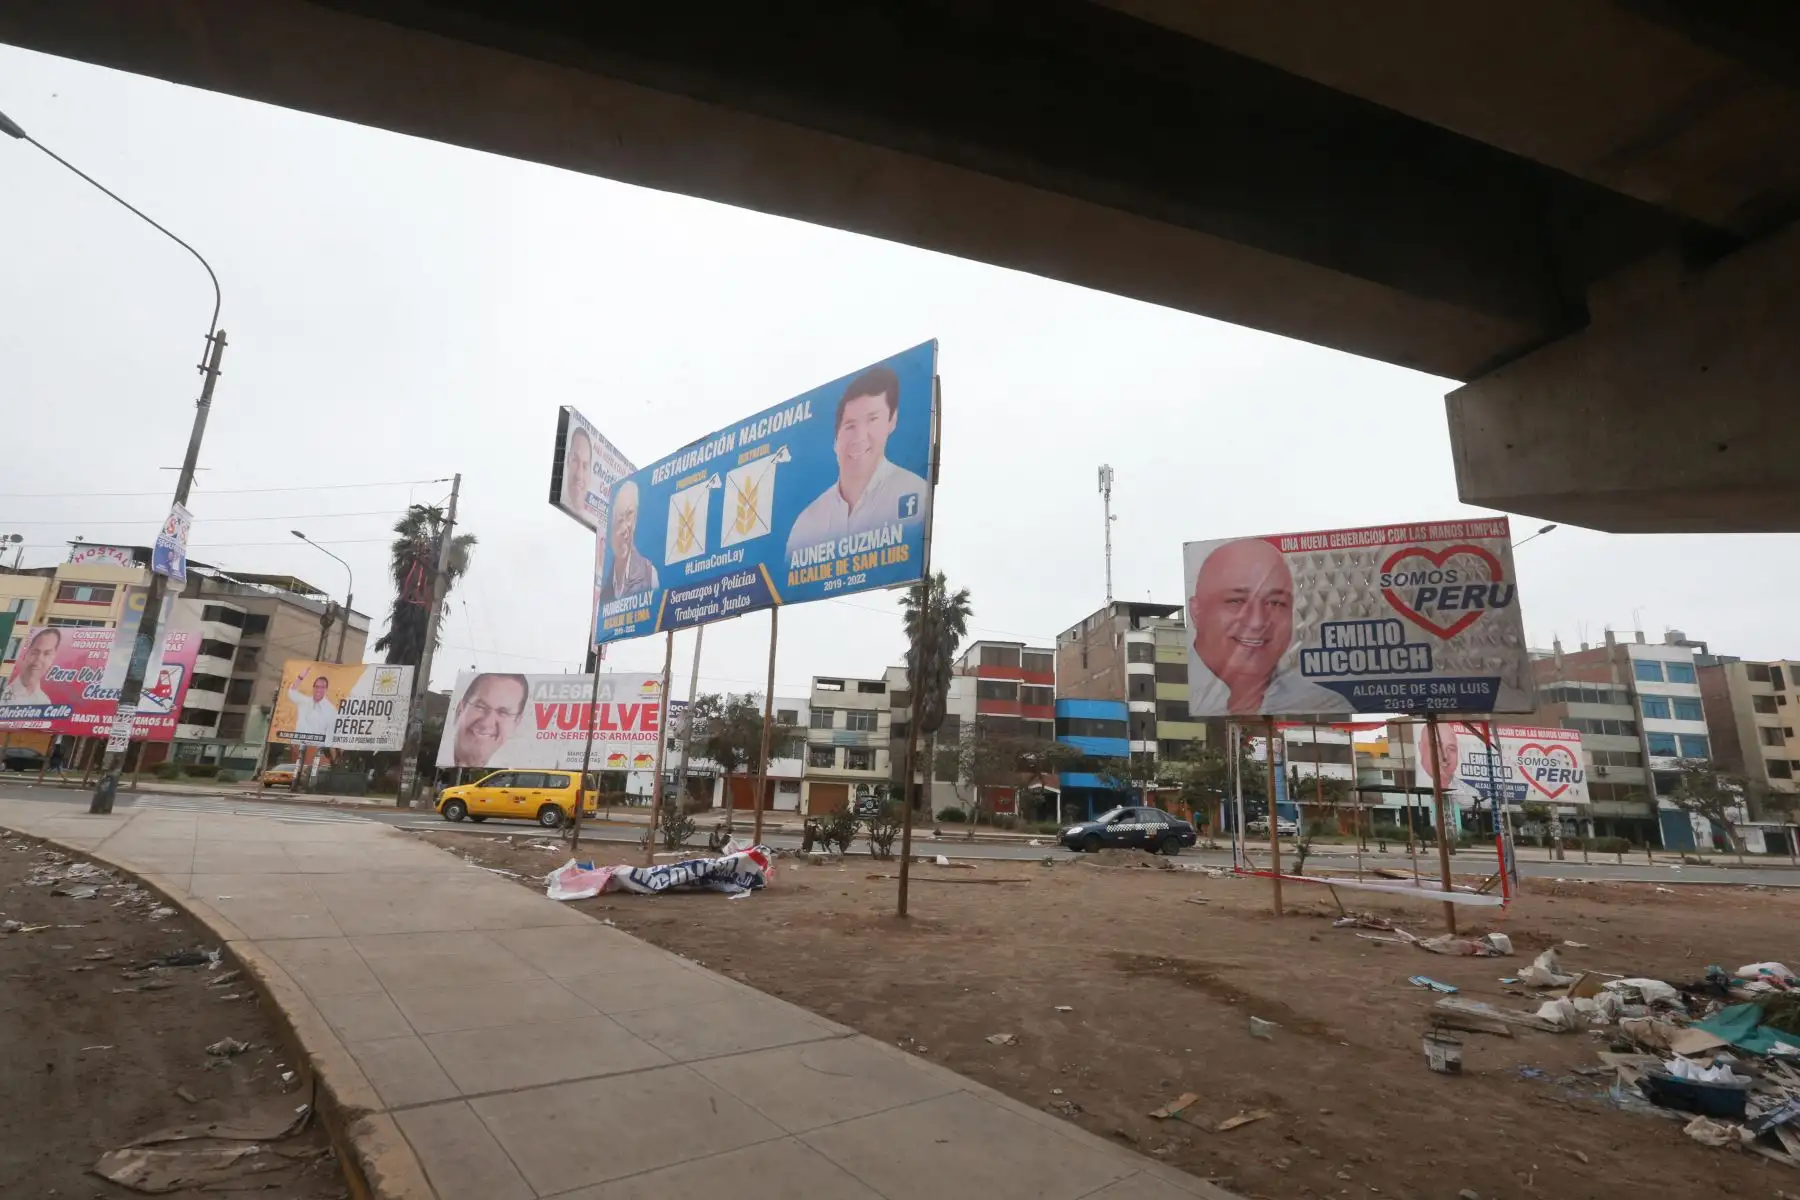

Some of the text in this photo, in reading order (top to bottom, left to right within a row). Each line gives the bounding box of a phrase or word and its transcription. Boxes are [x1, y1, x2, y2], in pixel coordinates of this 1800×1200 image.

[652, 431, 735, 486] RESTAURACIÓN
[738, 400, 813, 447] NACIONAL
[790, 522, 903, 569] AUNER GUZMÁN
[1281, 521, 1506, 552] UNA NUEVA GENERACIÓN CON LAS MANOS LIMPIAS
[75, 545, 130, 568] HOSTAL
[684, 548, 745, 576] #LimaConLay
[788, 544, 910, 586] ALCALDE DE SAN LUIS
[823, 579, 842, 591] 2019
[847, 573, 866, 585] 2022
[1380, 569, 1458, 587] SOMOS
[602, 590, 655, 618] HUMBERTO LAY
[670, 583, 713, 605] Serenazgos
[713, 584, 720, 598] y
[1414, 583, 1515, 611] PERU
[675, 594, 751, 622] Trabajarán Juntos
[1324, 621, 1400, 648] EMILIO
[1304, 647, 1430, 674] NICOLICH
[46, 665, 75, 682] Para
[535, 683, 614, 700] ALEGRA
[1353, 682, 1490, 696] ALCALDE DE SAN LUIS
[0, 704, 72, 718] Christian Calle
[338, 699, 393, 717] RICARDO
[1427, 698, 1457, 709] 2022
[162, 717, 175, 727] LA
[334, 715, 374, 735] PÉREZ
[534, 703, 660, 732] VUELVE
[535, 731, 659, 742] CON SERENOS ARMADOS
[1515, 728, 1526, 737] CON
[1527, 729, 1538, 738] LAS
[1517, 757, 1557, 767] SOMOS
[1535, 768, 1583, 783] PERU
